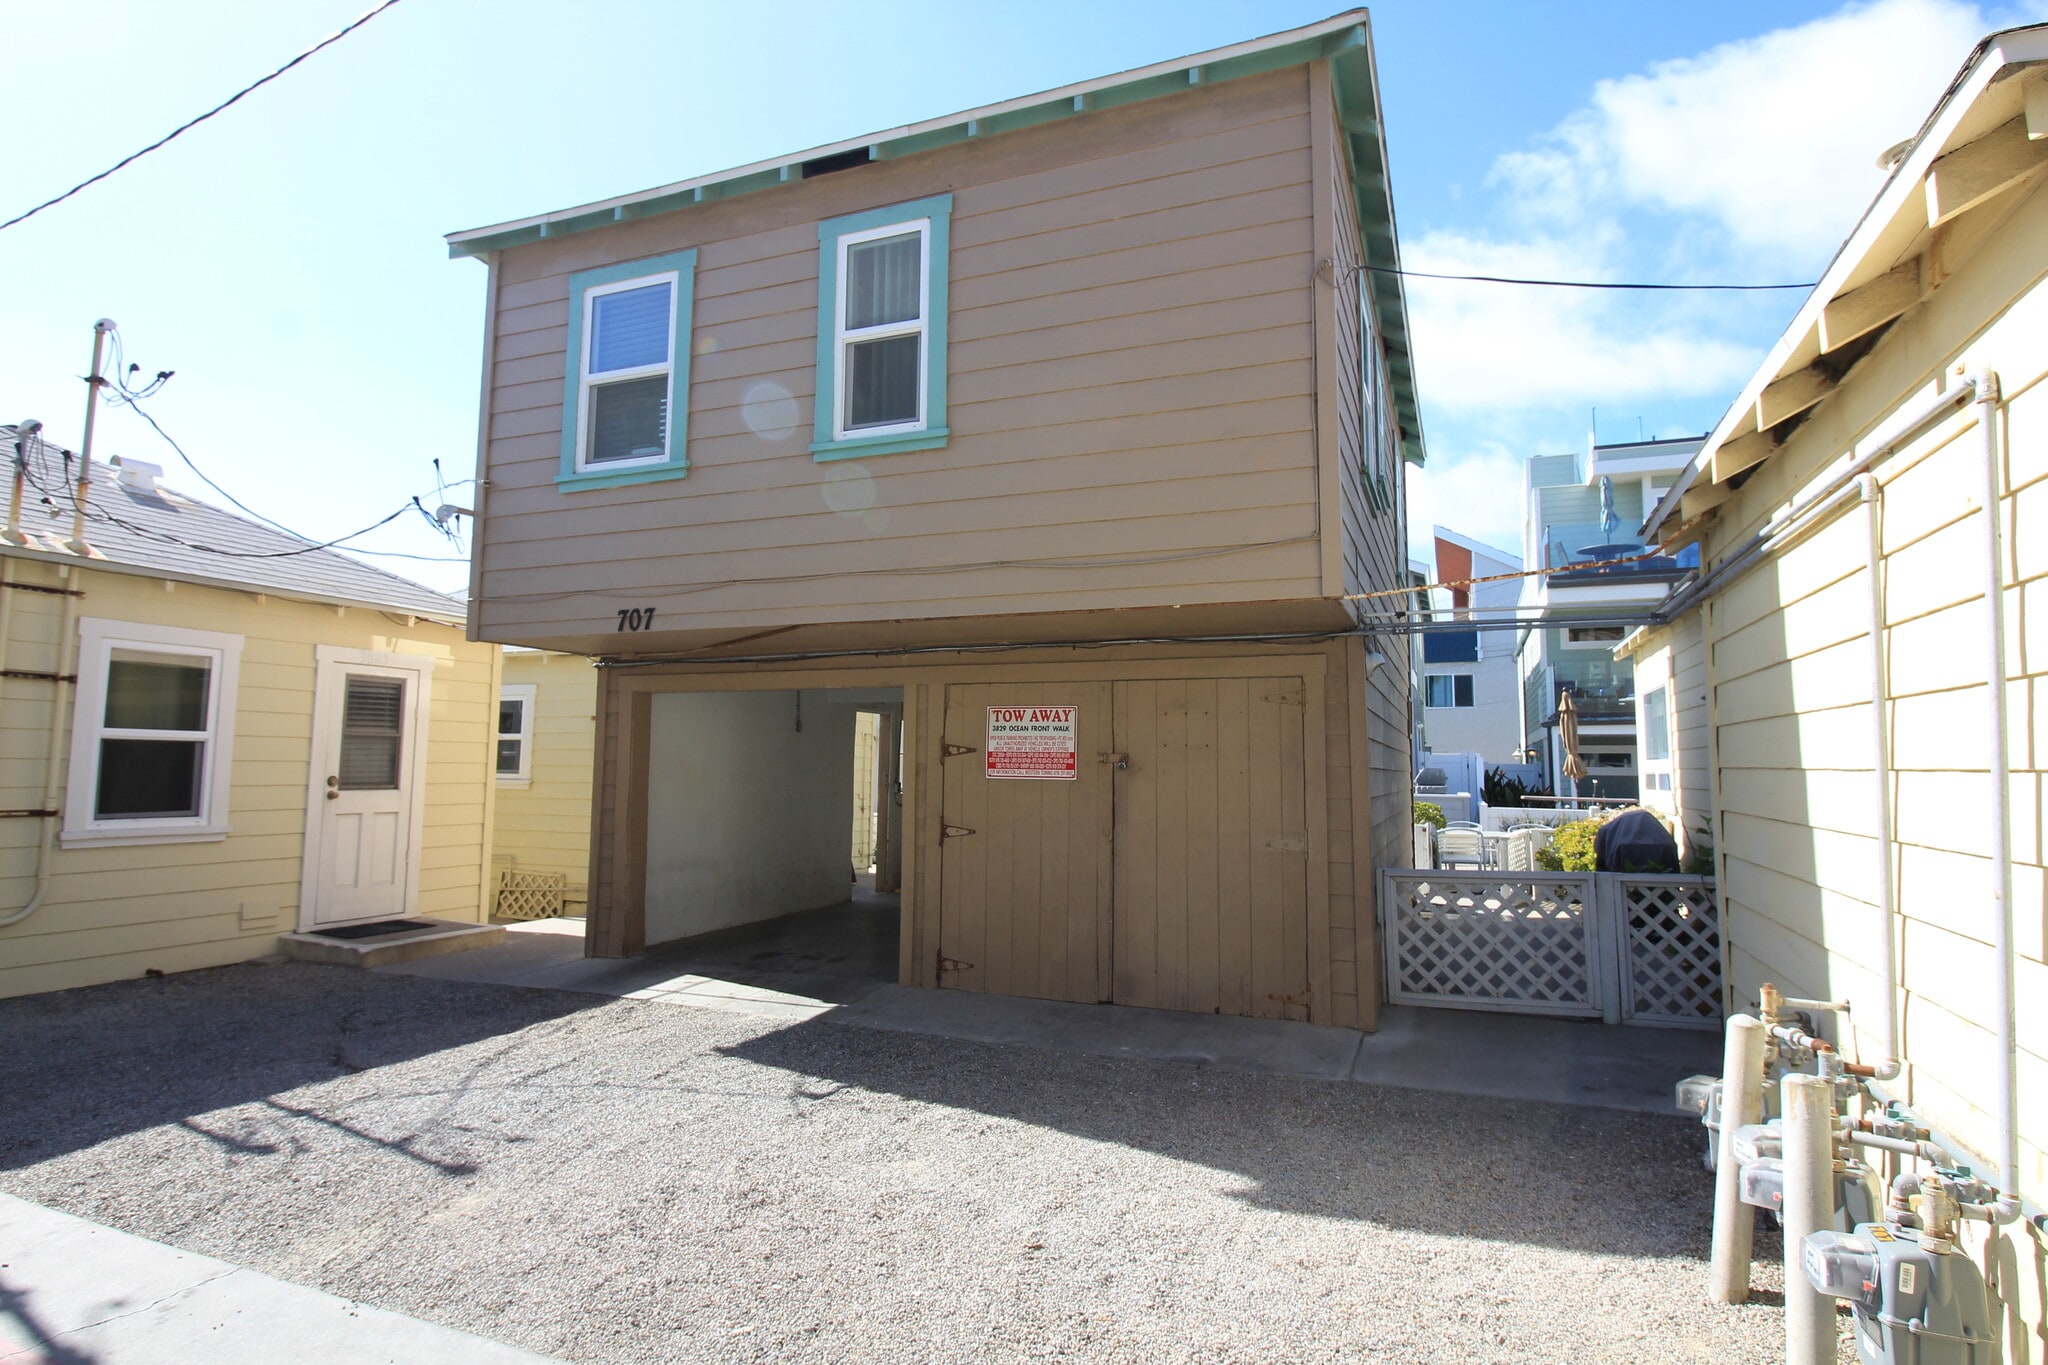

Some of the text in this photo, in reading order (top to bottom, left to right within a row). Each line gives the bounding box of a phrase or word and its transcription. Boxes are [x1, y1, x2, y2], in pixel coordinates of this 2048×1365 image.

[617, 606, 656, 632] 707
[992, 709, 1072, 723] TOW AWAY
